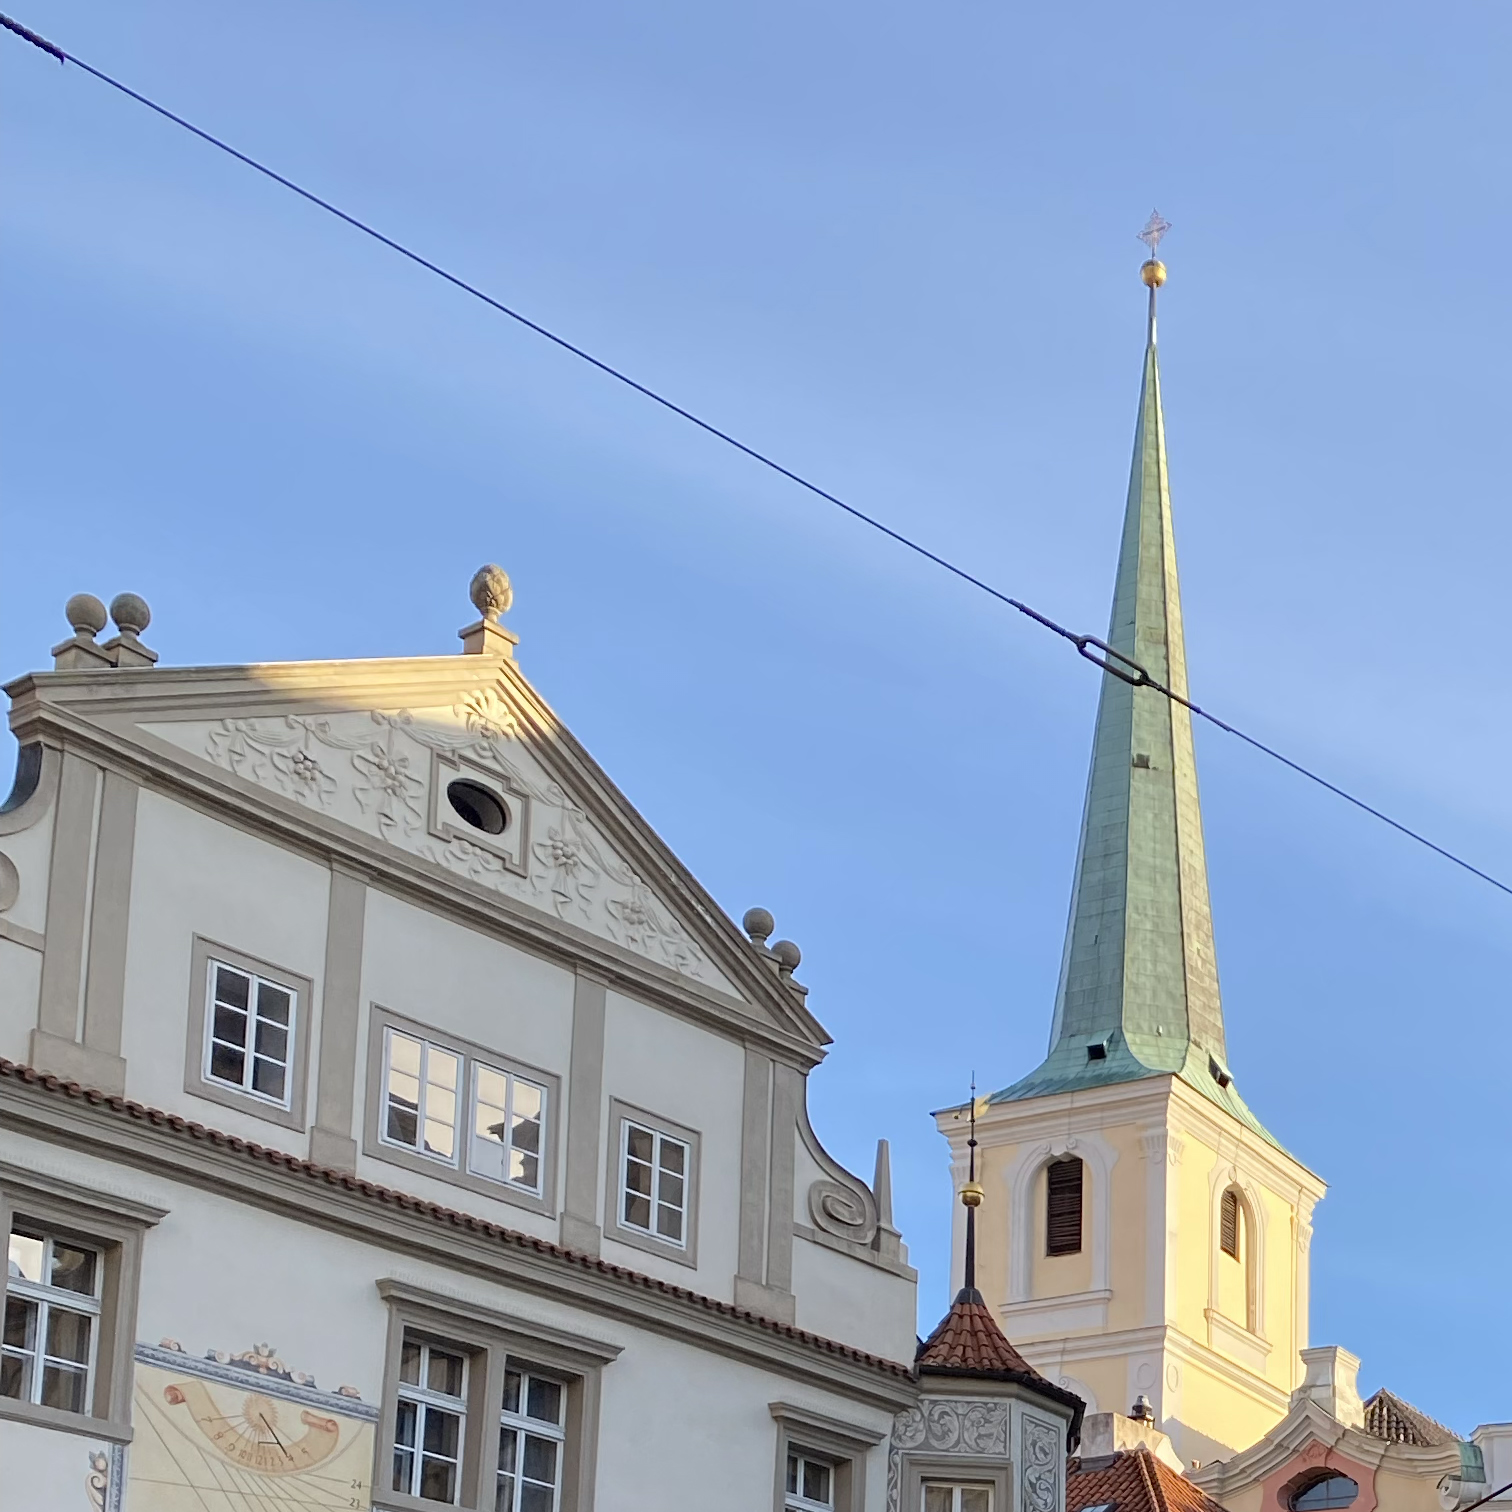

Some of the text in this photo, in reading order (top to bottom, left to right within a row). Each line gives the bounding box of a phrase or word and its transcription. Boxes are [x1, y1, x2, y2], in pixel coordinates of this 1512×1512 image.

[214, 1431, 224, 1440] 8
[350, 1479, 362, 1490] 24
[349, 1498, 360, 1509] 23
